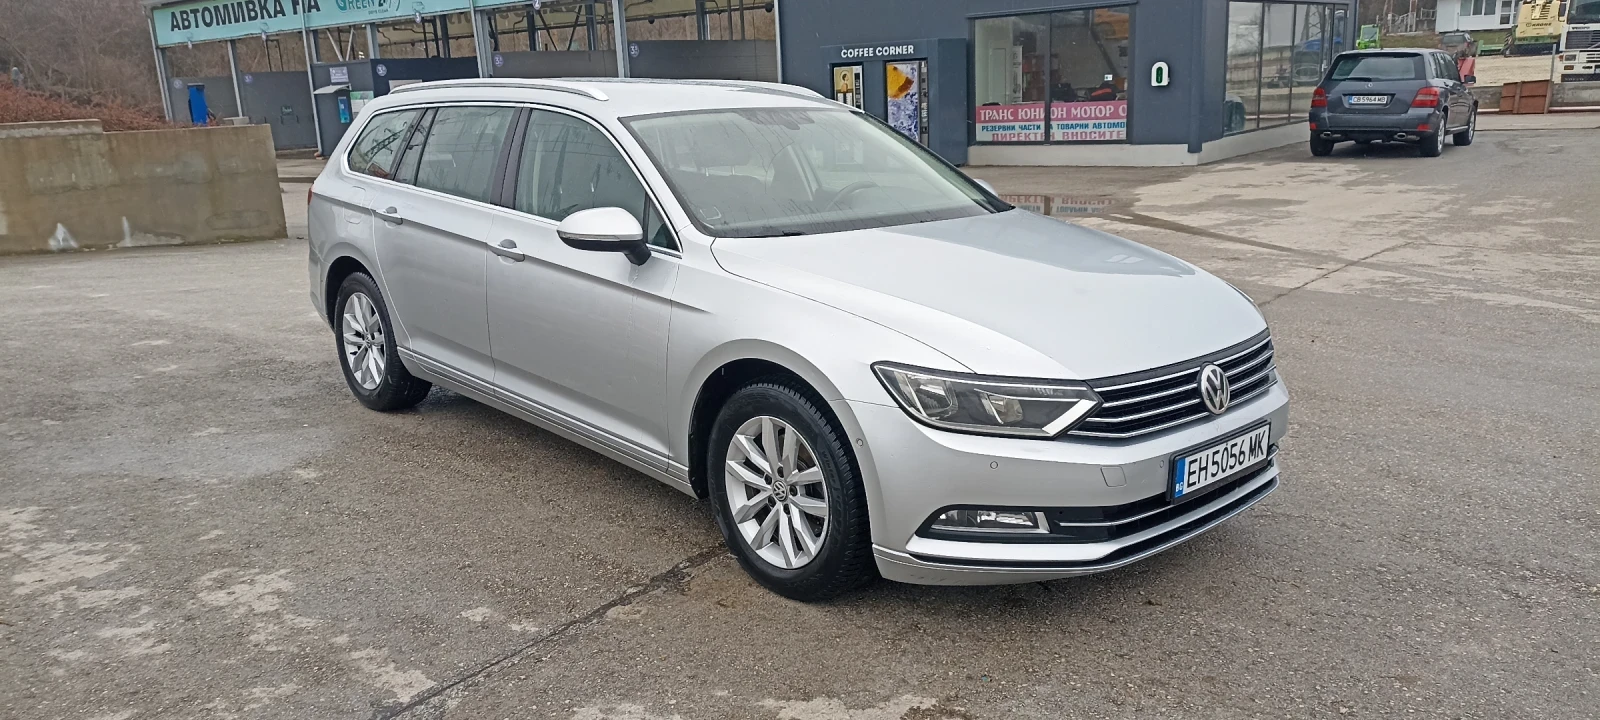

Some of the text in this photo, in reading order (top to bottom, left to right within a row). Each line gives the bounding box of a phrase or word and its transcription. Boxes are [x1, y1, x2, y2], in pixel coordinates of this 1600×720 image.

[170, 0, 286, 31] АВТОМИВКА
[841, 45, 914, 58] COFFEE CORNER
[980, 109, 1015, 120] ТРАНС
[1071, 105, 1115, 118] МОТОР
[1175, 481, 1184, 493] BG
